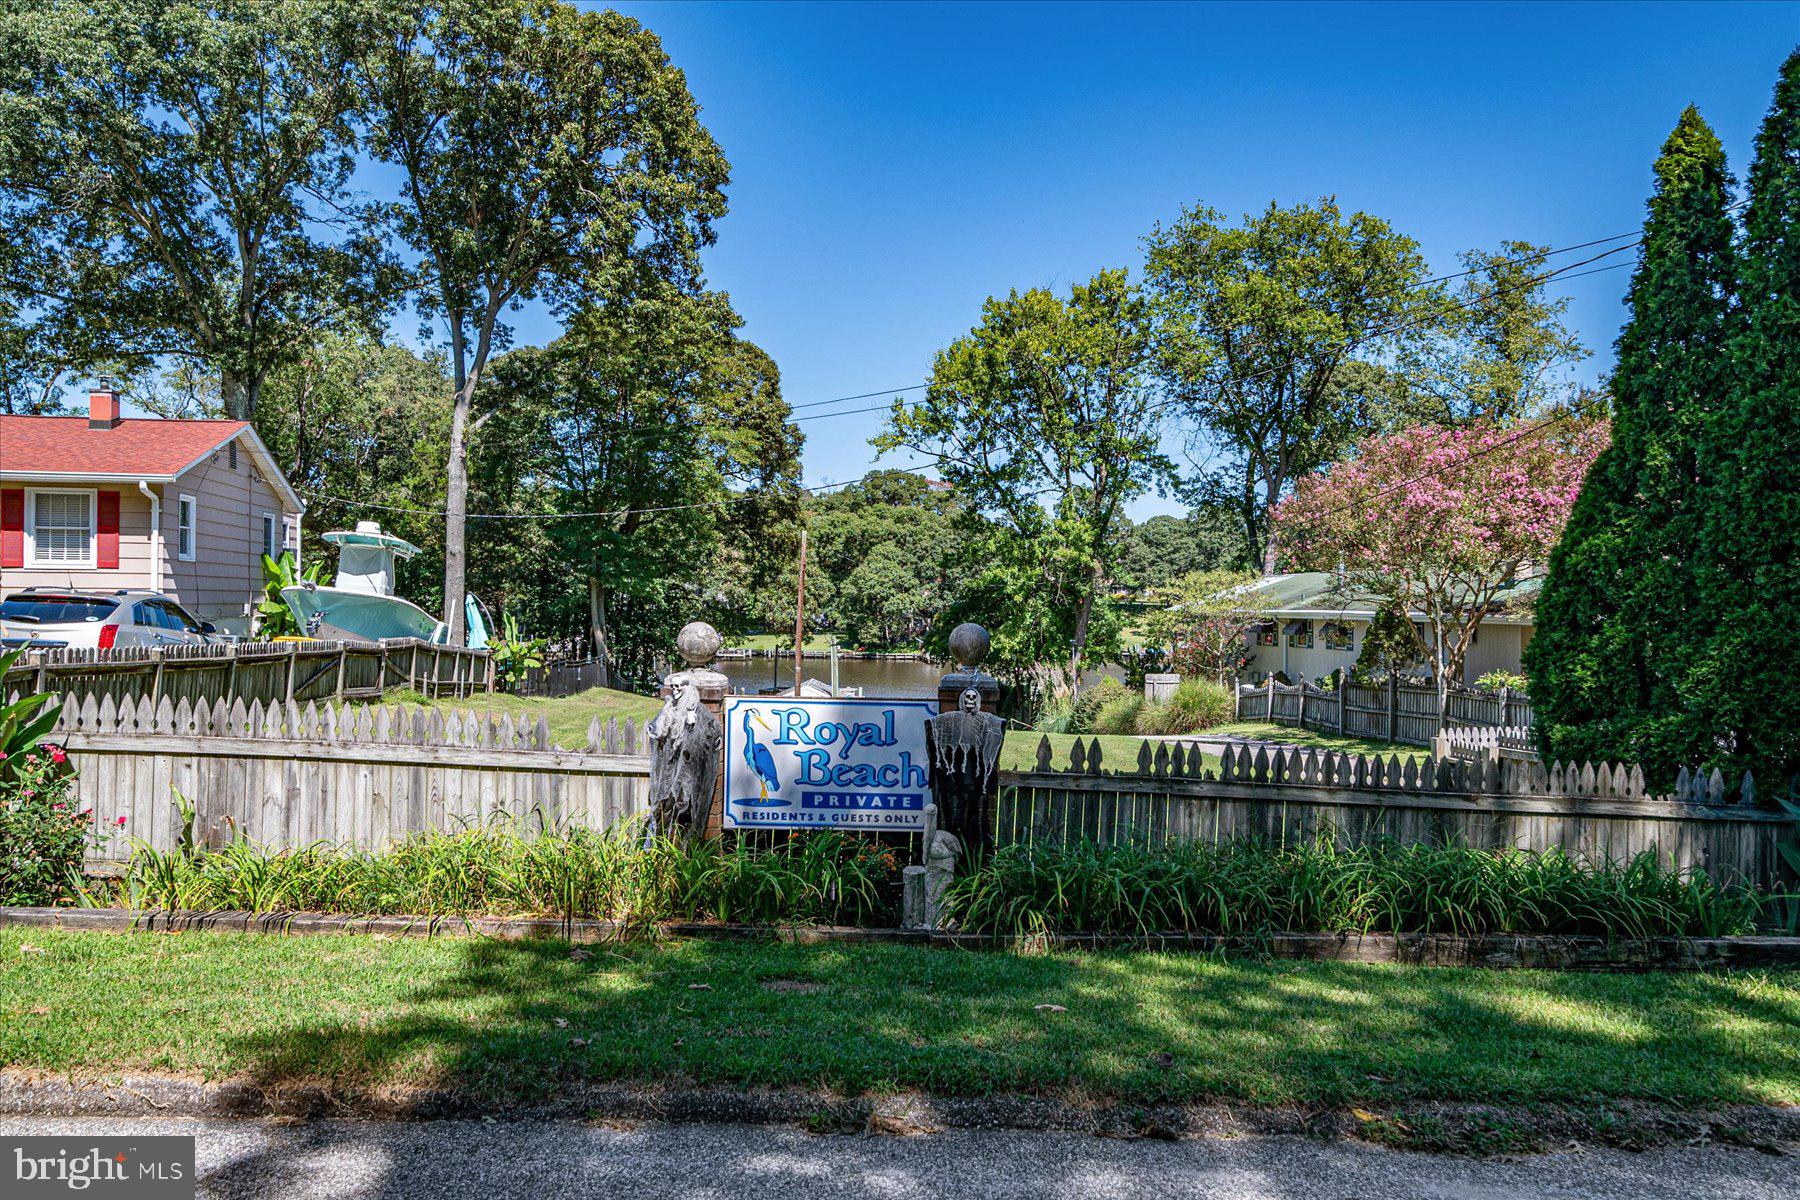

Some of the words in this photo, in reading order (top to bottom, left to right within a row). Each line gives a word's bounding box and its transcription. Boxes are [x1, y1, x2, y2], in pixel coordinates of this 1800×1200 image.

[771, 707, 898, 759] Royal
[794, 748, 928, 788] Beach
[814, 795, 911, 808] PRIVATE
[742, 811, 814, 822] RESIDENTS
[818, 813, 826, 822] &
[831, 813, 880, 823] GUESTS
[884, 814, 919, 824] ONLY
